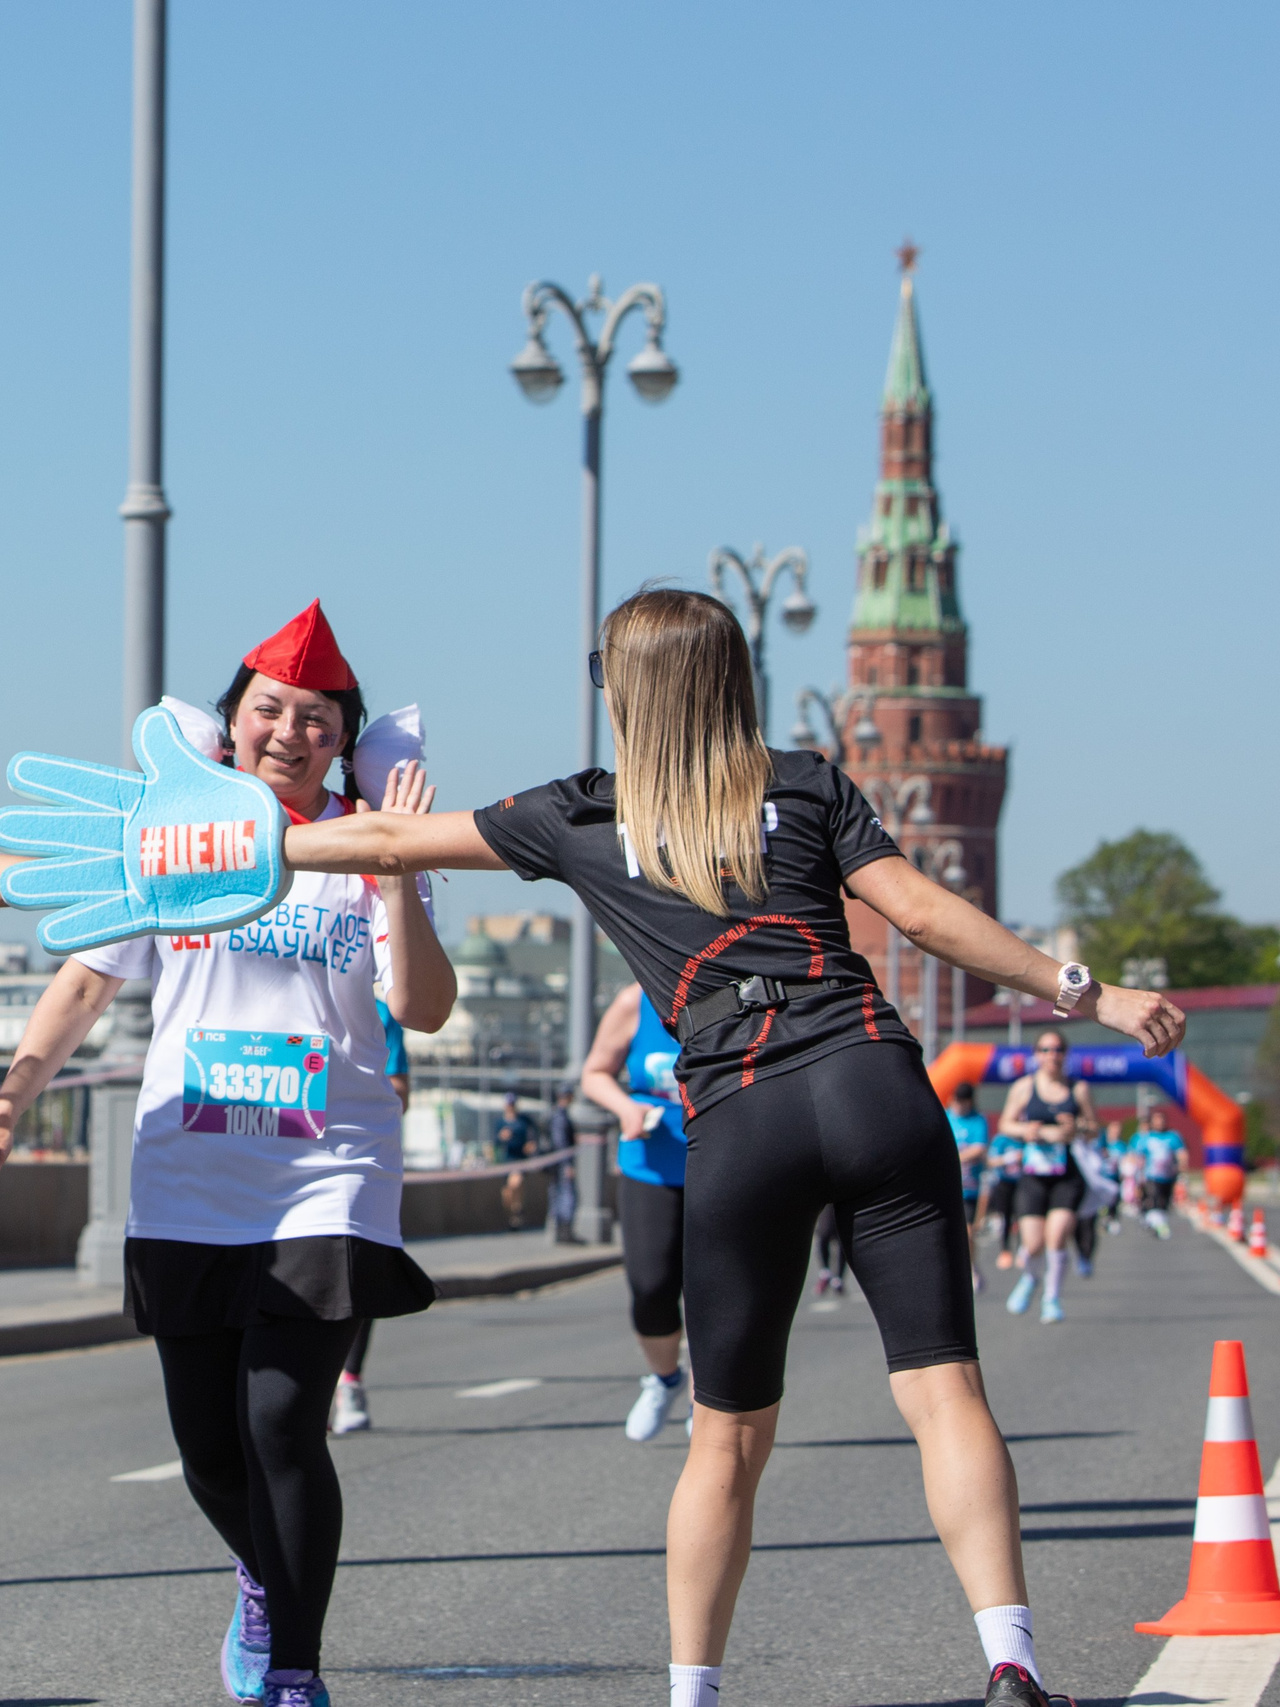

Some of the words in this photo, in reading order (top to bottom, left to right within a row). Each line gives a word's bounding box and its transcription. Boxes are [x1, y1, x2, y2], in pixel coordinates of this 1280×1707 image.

[141, 820, 257, 877] #ЦЕЛЬ
[228, 926, 357, 974] БУДУЩЕЕ
[205, 1032, 226, 1042] ПСБ
[209, 1062, 300, 1104] 33370
